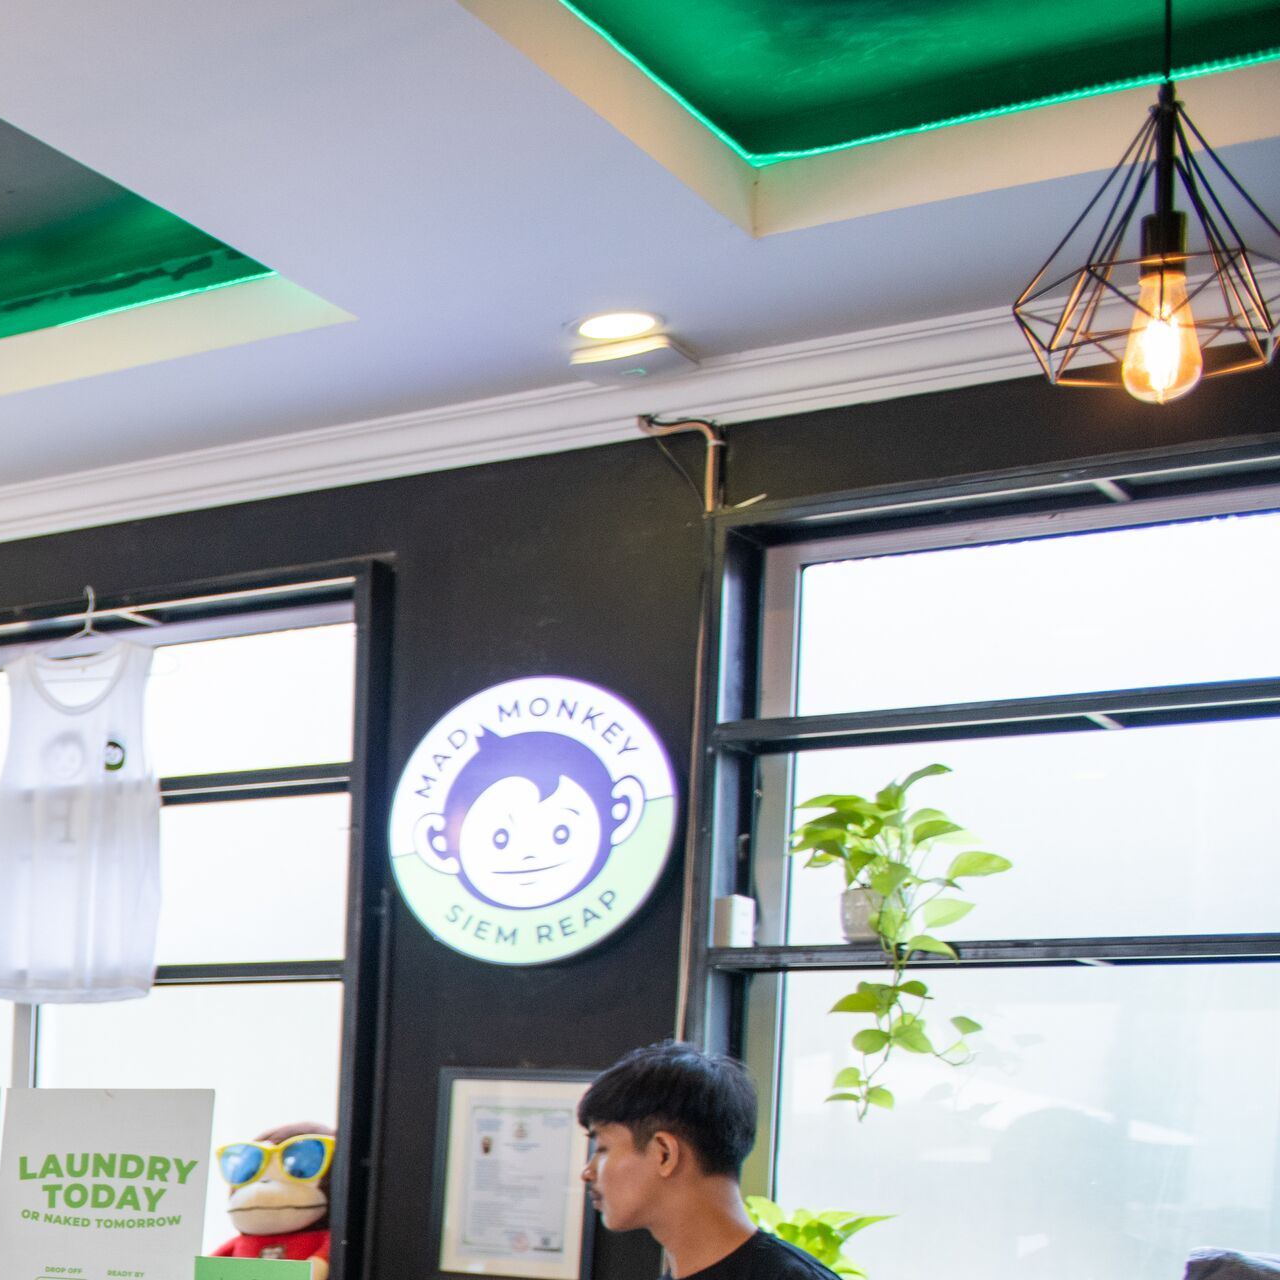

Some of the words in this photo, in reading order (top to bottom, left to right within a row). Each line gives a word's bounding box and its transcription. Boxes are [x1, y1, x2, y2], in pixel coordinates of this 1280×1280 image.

[414, 728, 468, 799] MAD
[498, 698, 638, 756] MONKEY
[446, 904, 519, 945] SIEM
[537, 889, 617, 944] REAP
[19, 1152, 199, 1184] LAUNDRY
[42, 1183, 167, 1212] TODAY
[21, 1209, 40, 1221] OR
[44, 1214, 91, 1227] NAKED
[95, 1215, 181, 1228] TOMORROW
